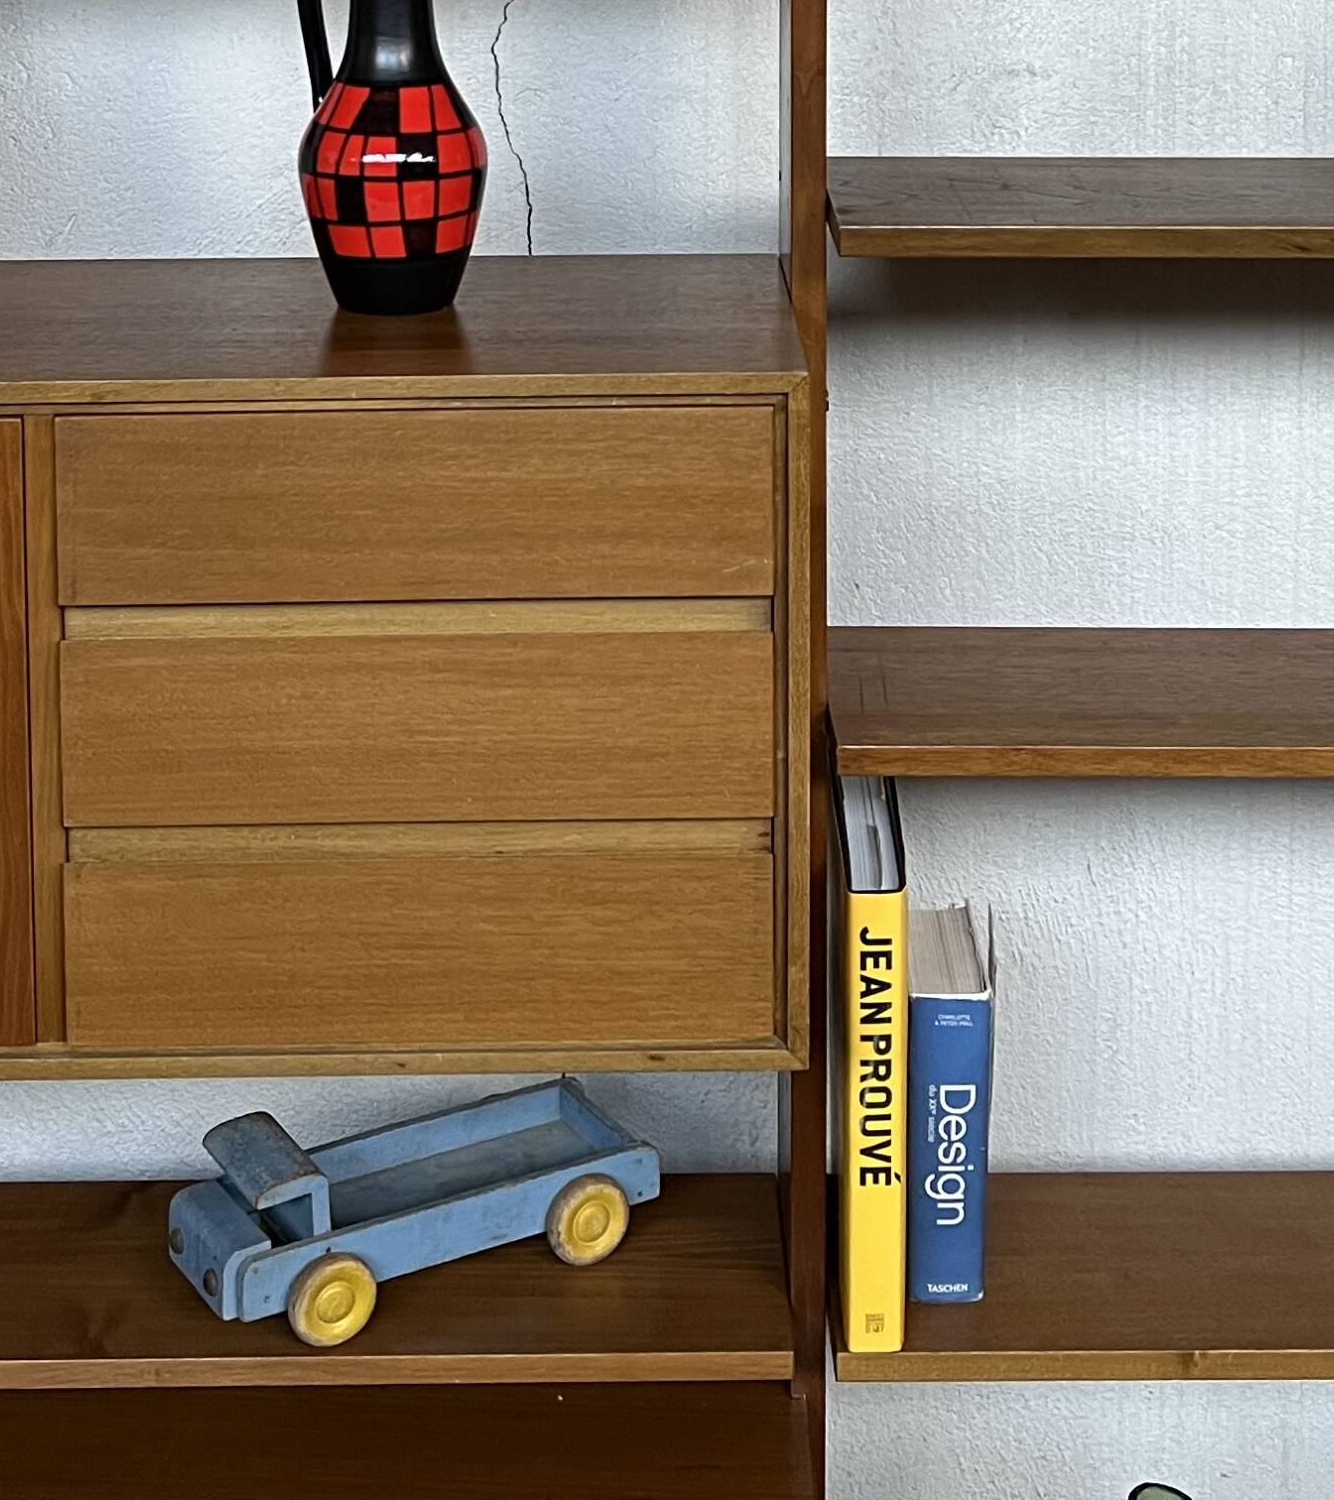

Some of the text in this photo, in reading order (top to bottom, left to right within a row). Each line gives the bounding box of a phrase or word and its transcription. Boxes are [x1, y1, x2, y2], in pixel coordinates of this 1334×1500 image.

[858, 926, 902, 1187] JEAN PROUVÉ
[924, 1083, 976, 1226] Design
[926, 1282, 969, 1294] TASCHEN
